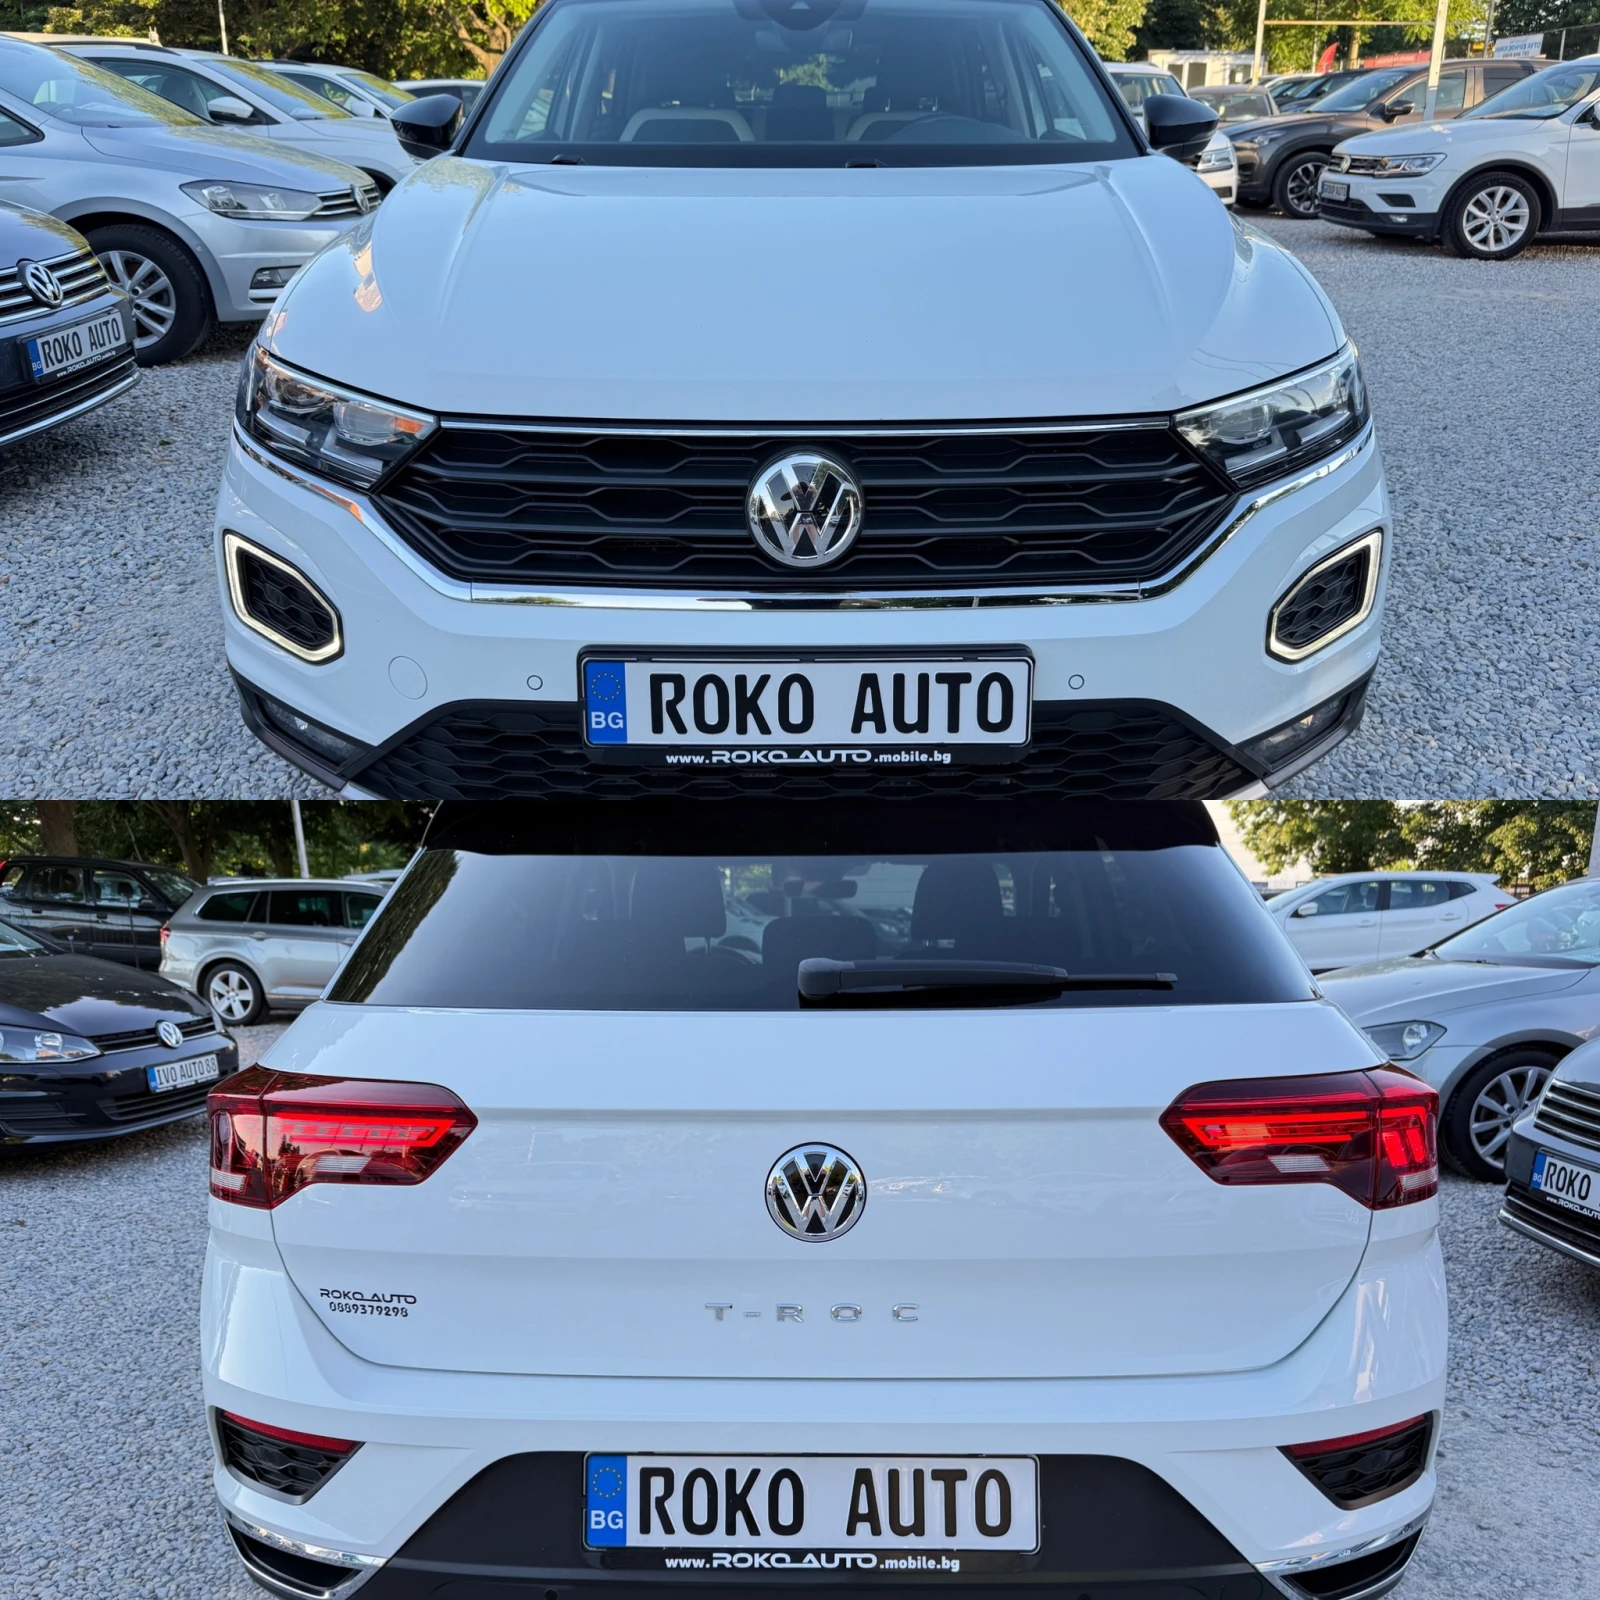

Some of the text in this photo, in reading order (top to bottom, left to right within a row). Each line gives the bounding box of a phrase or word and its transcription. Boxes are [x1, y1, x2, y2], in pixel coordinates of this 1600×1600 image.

[41, 317, 121, 368] ROKO AUTO
[32, 361, 42, 371] BG
[649, 671, 1014, 735] ROKO AUTO
[590, 711, 624, 729] BG
[157, 1057, 217, 1085] IVO AUTO 88
[1532, 1172, 1542, 1183] BG
[1544, 1161, 1591, 1201] ROKO
[329, 1301, 409, 1318] 0889379298
[639, 1467, 1012, 1537] ROKO AUTO
[590, 1510, 624, 1530] BG
